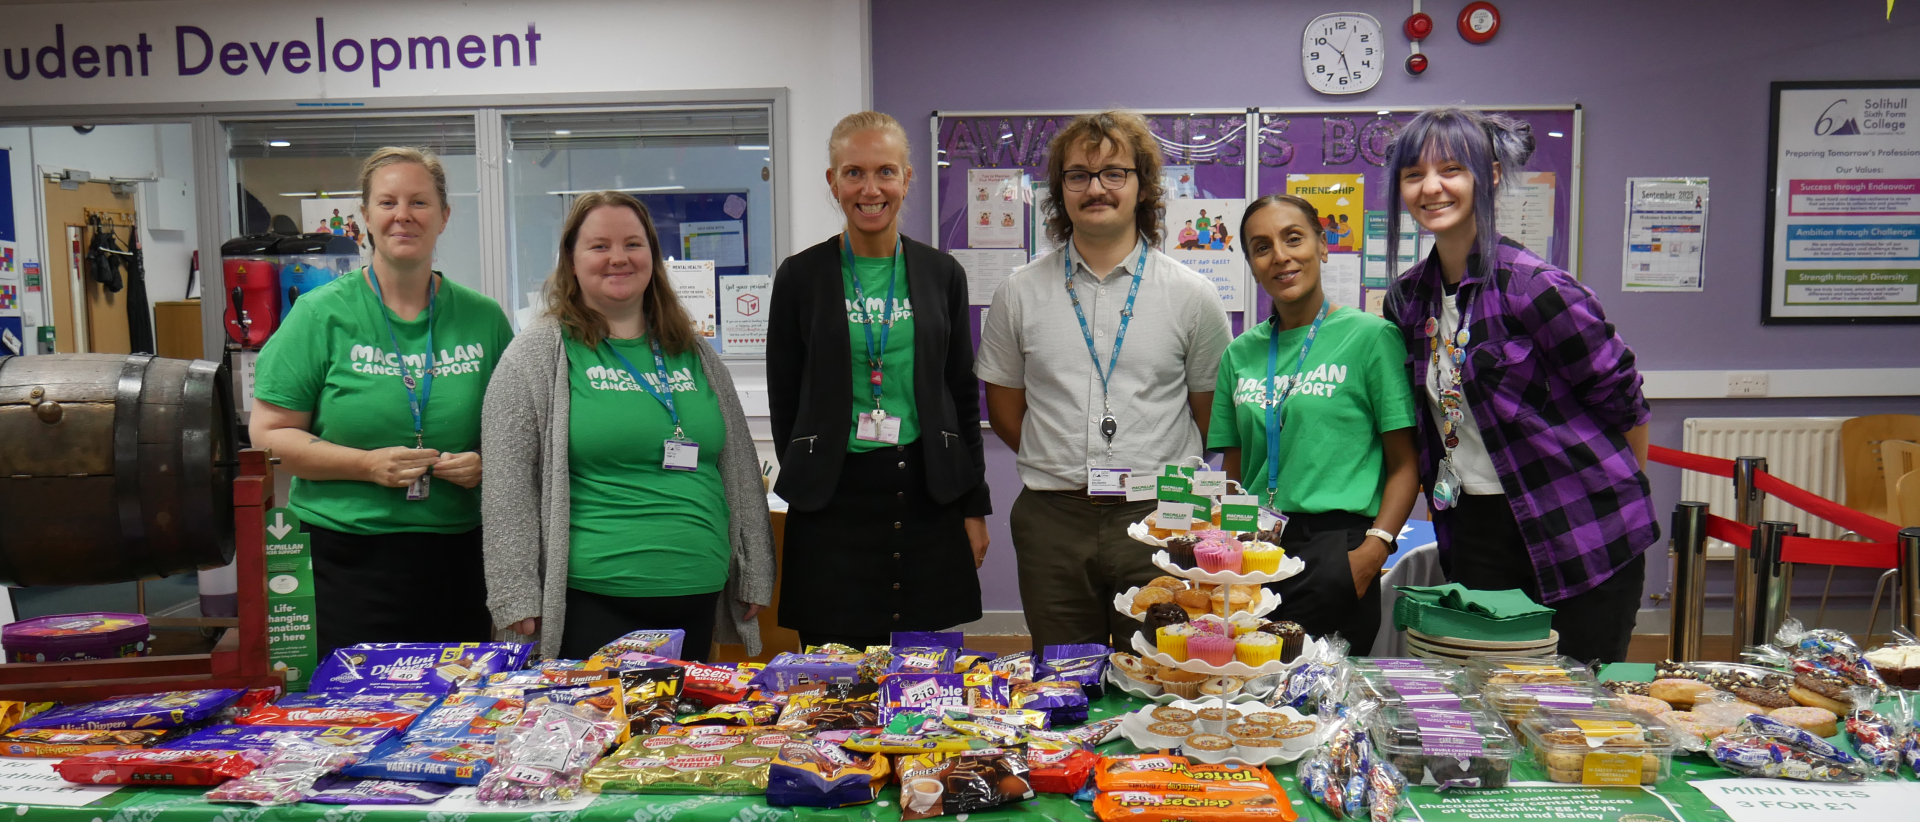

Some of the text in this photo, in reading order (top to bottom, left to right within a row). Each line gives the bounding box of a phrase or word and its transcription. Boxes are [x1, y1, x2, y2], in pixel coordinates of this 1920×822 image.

[1335, 22, 1346, 30] 12
[1325, 27, 1333, 36] 11
[1315, 37, 1327, 45] 10
[1361, 35, 1369, 43] 2
[4, 17, 541, 88] udent Development
[1310, 52, 1319, 60] 9
[1362, 60, 1370, 68] 4
[1317, 65, 1325, 73] 8
[1327, 73, 1334, 81] 7
[1339, 77, 1348, 85] 6
[1864, 98, 1907, 109] Solihull
[1864, 110, 1883, 118] Sixth
[1863, 119, 1906, 131] College
[1786, 149, 1825, 159] Preparing
[1828, 149, 1875, 157] Tomorrow's
[1836, 166, 1884, 174] Our Values:
[1800, 182, 1916, 192] Success through Endeavour:
[1642, 191, 1676, 200] September
[1796, 228, 1916, 237] Ambition through Challenge:
[1799, 273, 1909, 282] Strength through Diversity:
[352, 362, 411, 376] CANCE
[590, 380, 643, 392] CANCER
[274, 604, 297, 613] Life-
[268, 613, 309, 623] hanging
[268, 623, 311, 633] onations
[269, 632, 306, 644] go here
[393, 654, 436, 667] Mini
[399, 672, 413, 680] 40
[685, 665, 731, 680] tesers
[570, 674, 602, 683] Limited
[911, 688, 935, 703] 210
[644, 740, 679, 748] WHEELS
[676, 755, 721, 763] WAGON
[386, 761, 447, 775] VARIETY PACK
[1137, 761, 1165, 770] 280
[457, 766, 471, 777] 5X
[515, 771, 542, 783] 145
[1720, 786, 1871, 799] MINI BITES
[1528, 799, 1585, 807] contain
[1760, 801, 1821, 811] FOR
[1545, 805, 1578, 813] Egg,
[1579, 805, 1622, 813] Soya,
[1556, 812, 1604, 820] Barley
